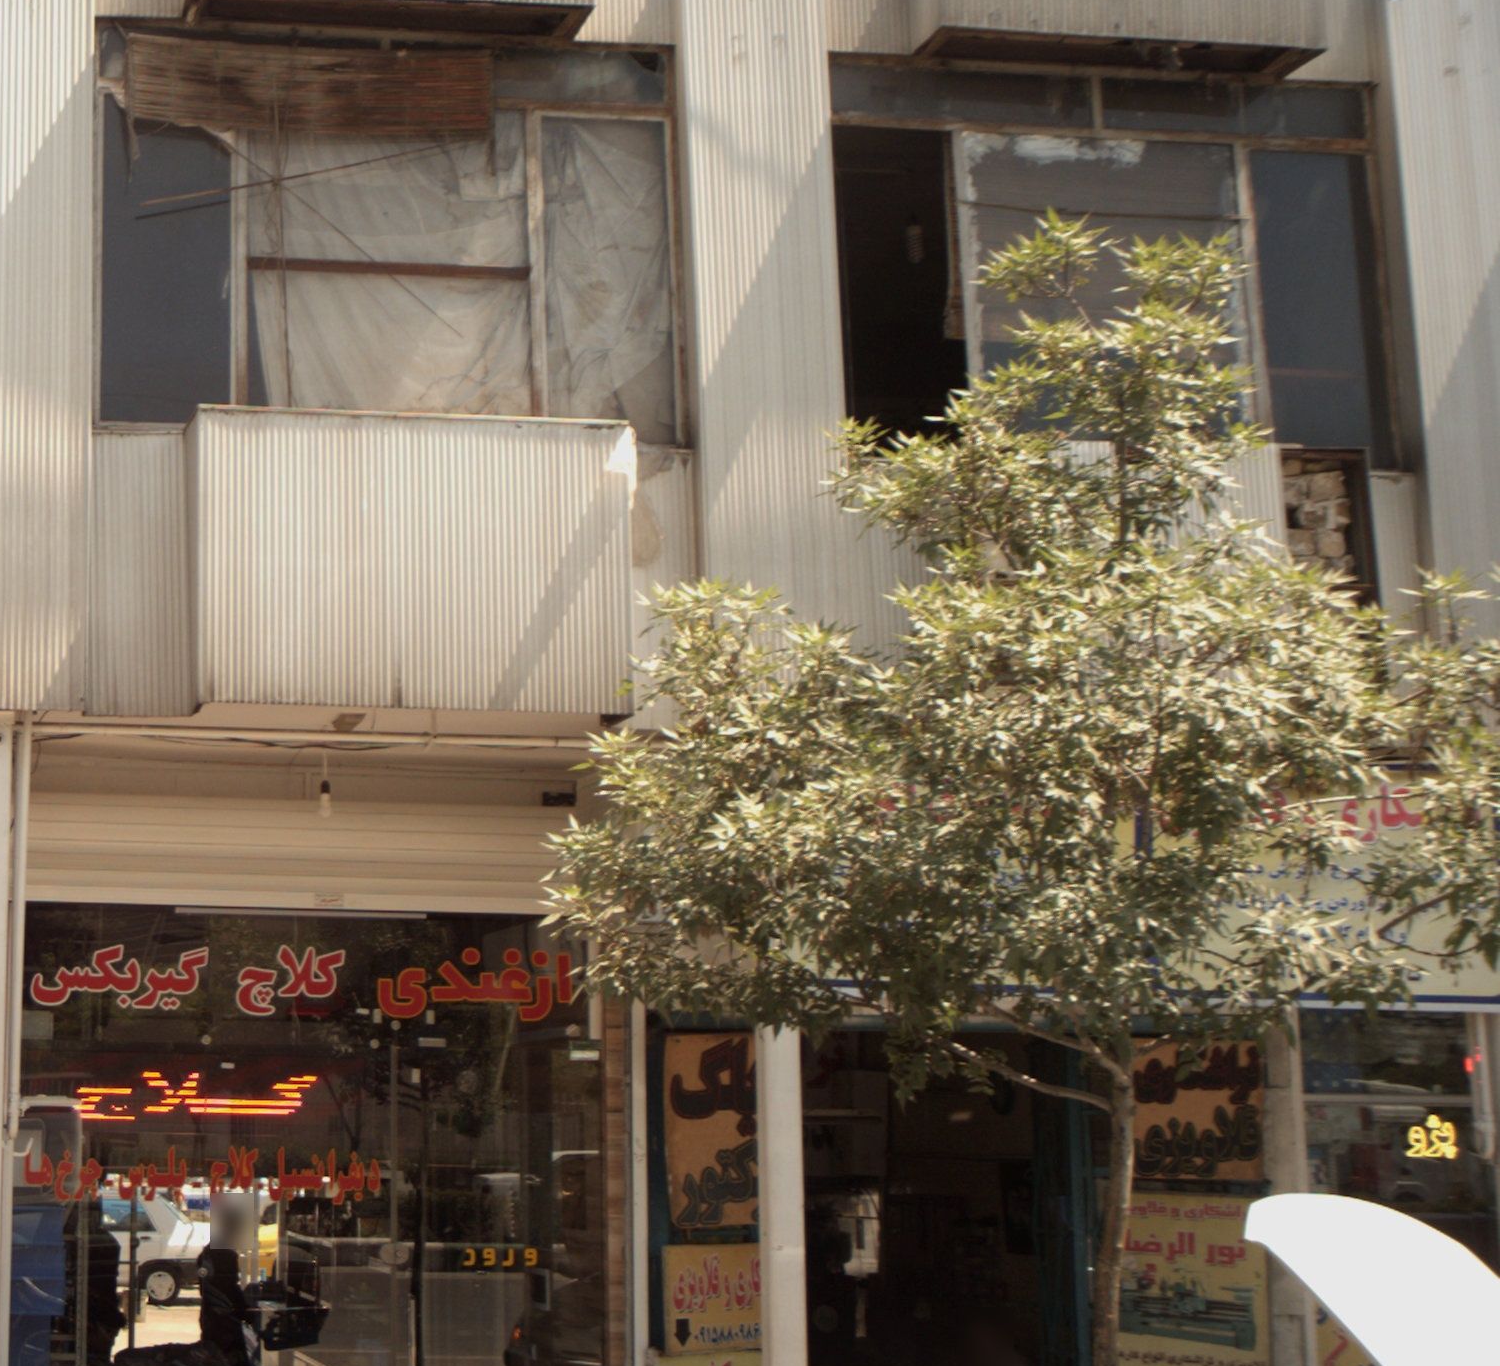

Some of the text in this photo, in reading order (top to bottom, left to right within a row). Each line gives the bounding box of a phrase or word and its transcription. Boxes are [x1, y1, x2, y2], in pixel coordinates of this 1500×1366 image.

[30, 943, 574, 1023] ازغندی کلاچ گیربکس
[1405, 1114, 1459, 1159] پژو
[677, 1138, 758, 1227] کتور
[462, 1247, 540, 1268] ورود
[1205, 1238, 1247, 1265] نور
